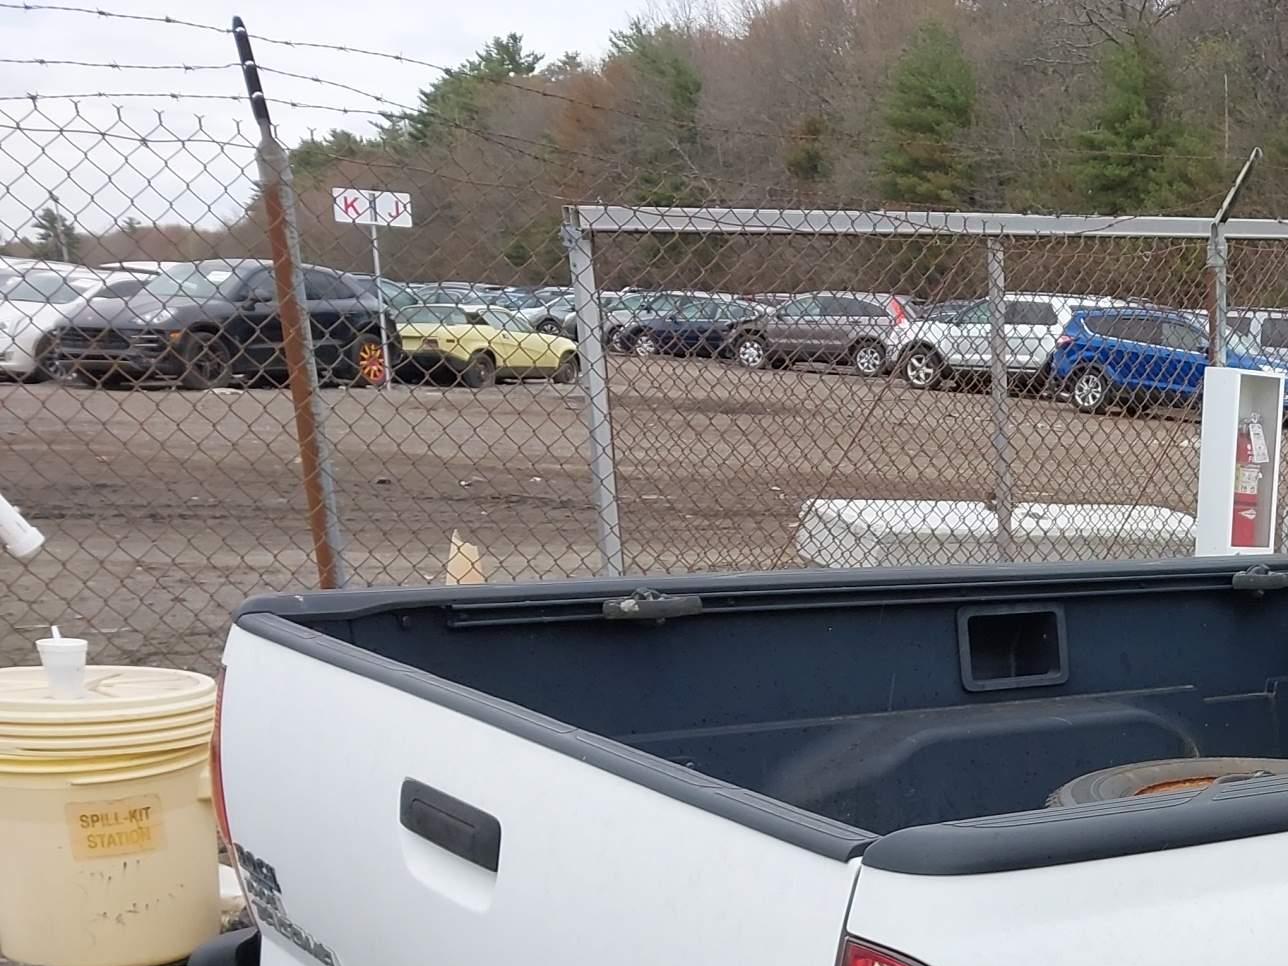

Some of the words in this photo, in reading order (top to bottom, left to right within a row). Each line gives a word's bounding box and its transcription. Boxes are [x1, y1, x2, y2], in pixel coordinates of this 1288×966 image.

[343, 196, 361, 216] K
[79, 806, 152, 829] SPILL-KIT
[87, 827, 152, 849] STATION
